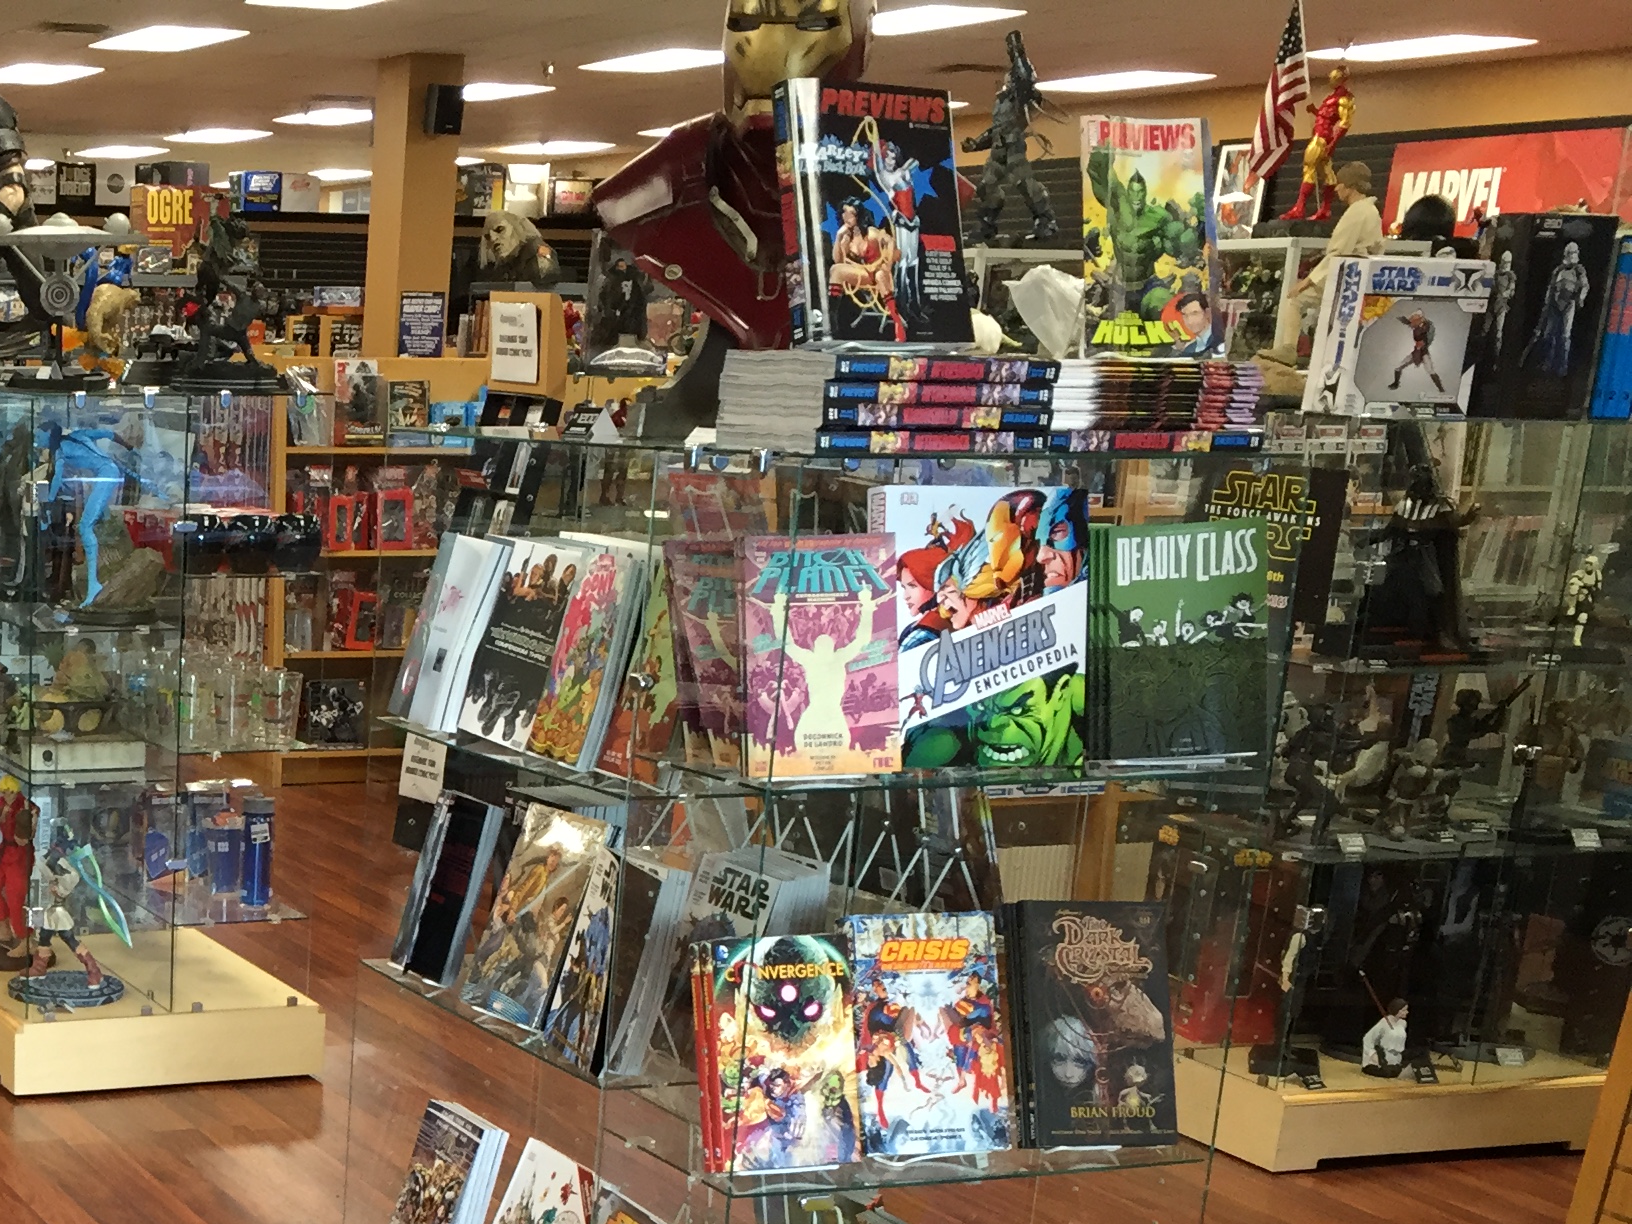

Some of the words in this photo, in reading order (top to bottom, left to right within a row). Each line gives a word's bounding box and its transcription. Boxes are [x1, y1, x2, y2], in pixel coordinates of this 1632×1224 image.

[820, 88, 945, 123] PREVIEWS
[147, 189, 193, 224] OGRE
[1372, 266, 1422, 281] STAR
[1372, 277, 1418, 292] WARS
[1213, 470, 1317, 514] STAR
[1227, 504, 1261, 518] FORCE
[1267, 510, 1321, 527] AWAKNS
[768, 547, 870, 567] BITCH
[1117, 533, 1192, 587] DEADLY
[1196, 528, 1258, 582] CLASS
[752, 565, 891, 594] PLANET
[974, 603, 1012, 630] MARVEL
[919, 604, 1057, 709] AVENGERS
[975, 643, 1078, 694] ENCYCLOPEDIA
[712, 867, 770, 902] STAR
[880, 938, 969, 961] CRISIS
[1070, 1107, 1108, 1118] BRIAN
[1112, 1107, 1156, 1118] FROUD
